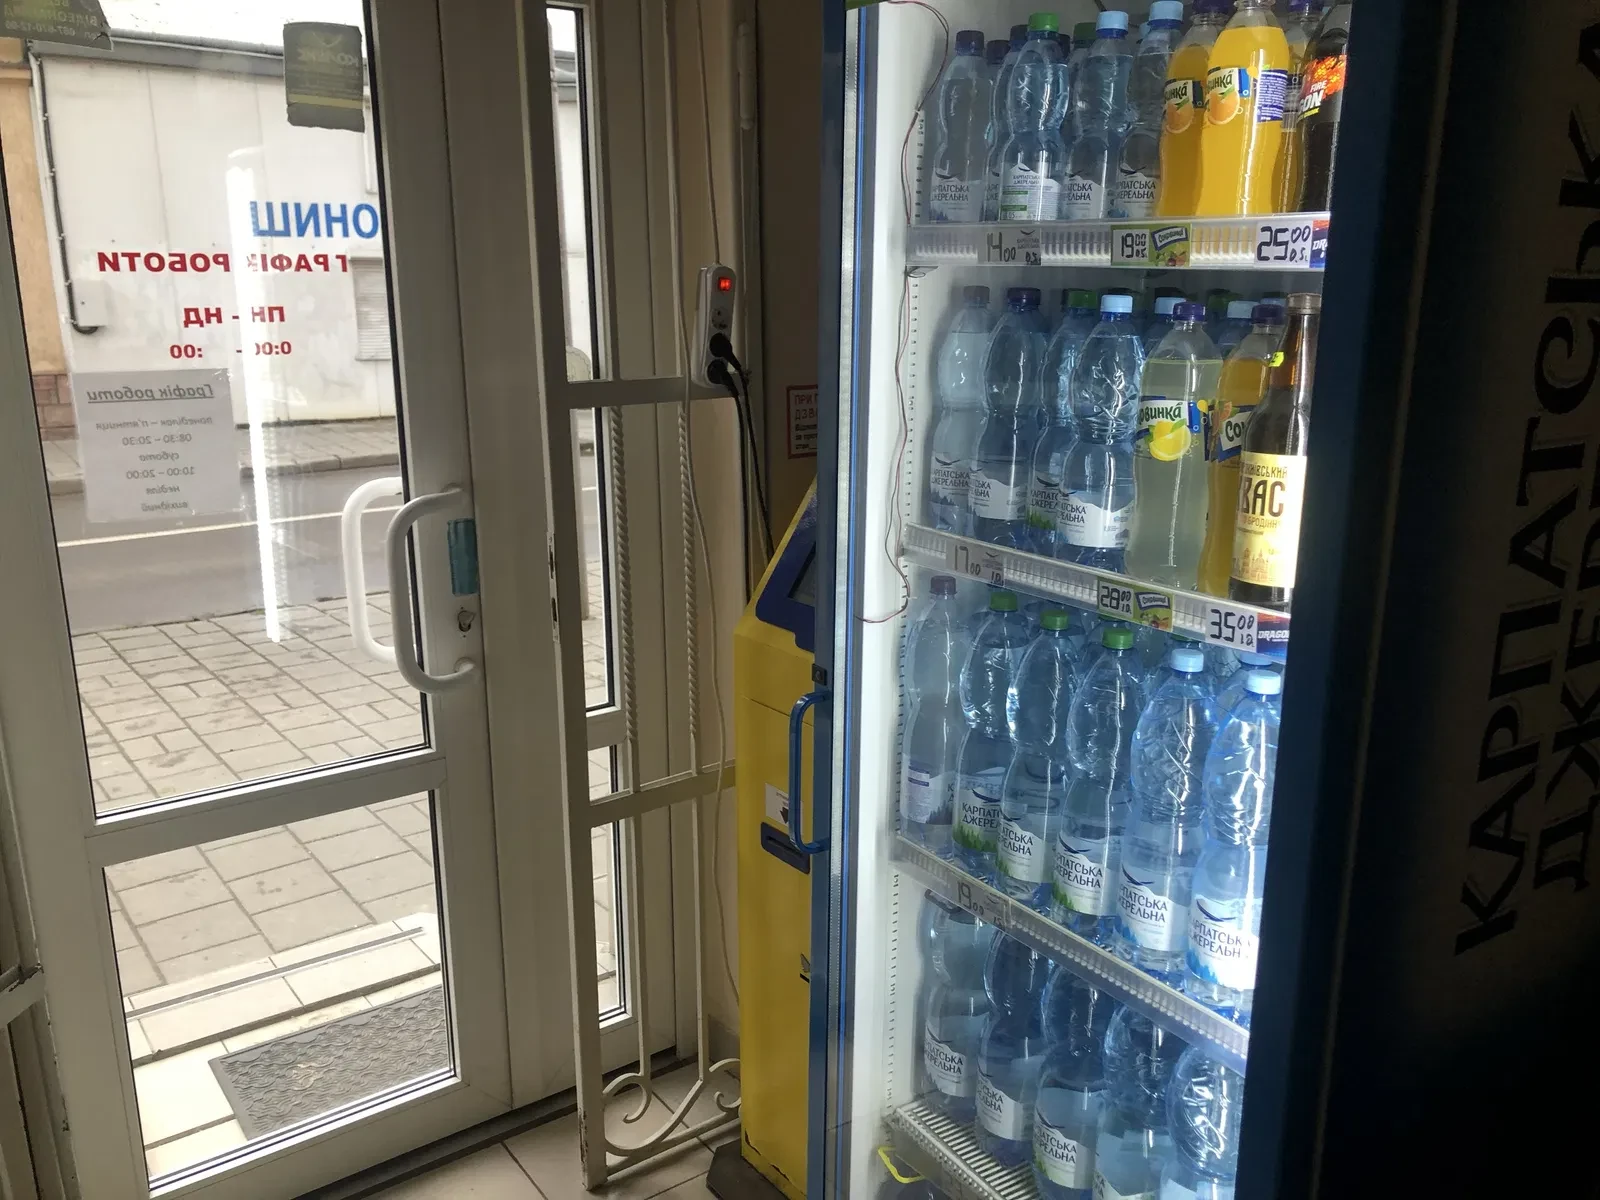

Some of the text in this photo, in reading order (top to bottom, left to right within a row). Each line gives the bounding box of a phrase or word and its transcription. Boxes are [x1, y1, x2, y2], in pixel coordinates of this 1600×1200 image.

[1311, 79, 1327, 93] FIRE
[986, 231, 1003, 262] 14
[1004, 246, 1017, 262] 00
[1121, 232, 1147, 259] 19 00
[1257, 224, 1311, 261] 25 00
[1238, 476, 1286, 518] ВАС
[1100, 585, 1121, 610] 28
[1210, 608, 1236, 643] 35
